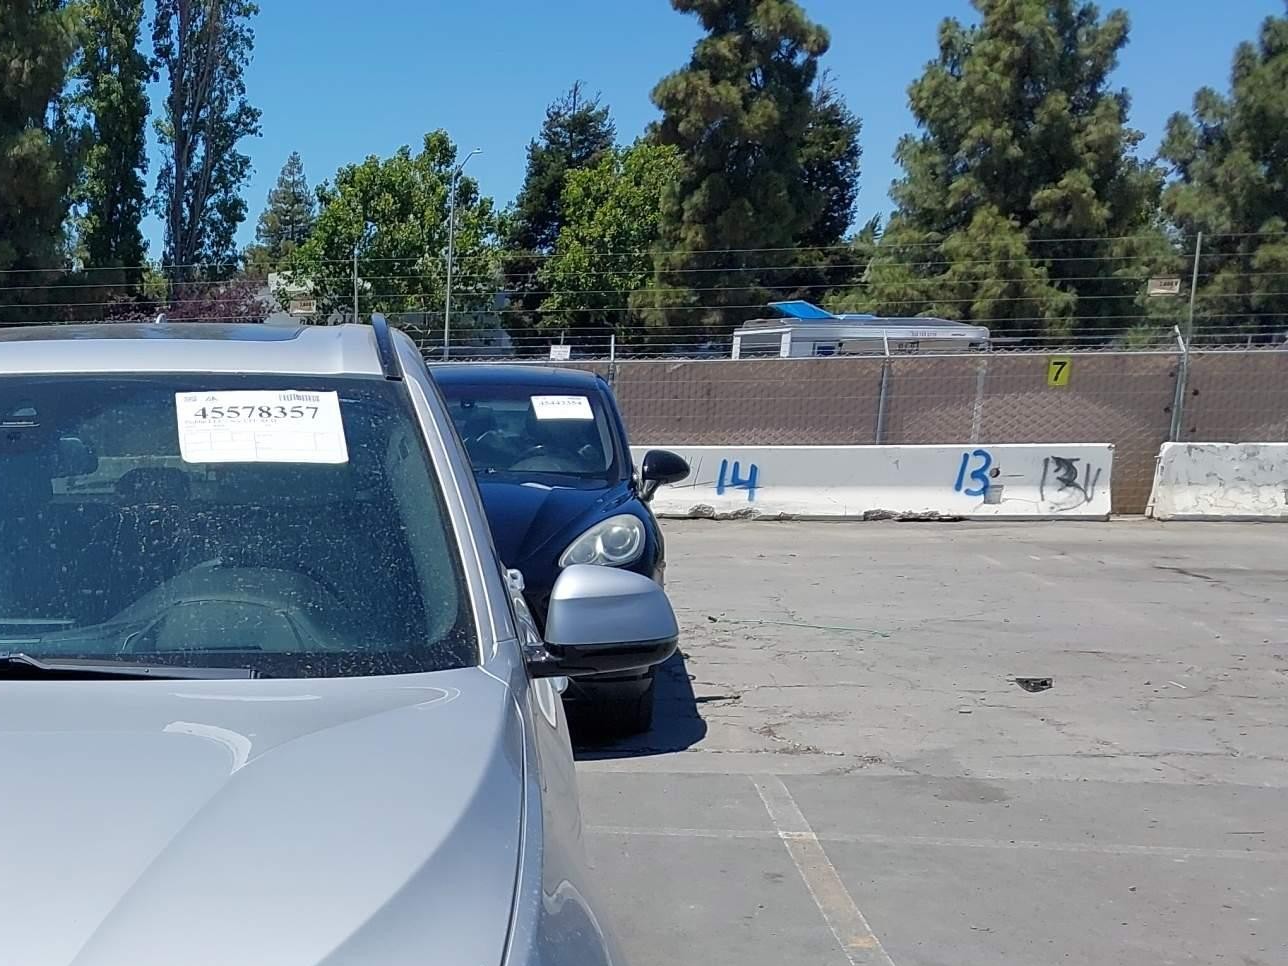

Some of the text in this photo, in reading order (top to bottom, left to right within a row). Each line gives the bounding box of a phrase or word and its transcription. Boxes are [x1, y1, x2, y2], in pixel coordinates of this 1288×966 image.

[1052, 361, 1067, 382] 7
[194, 405, 320, 420] 45578357
[715, 458, 759, 502] 14
